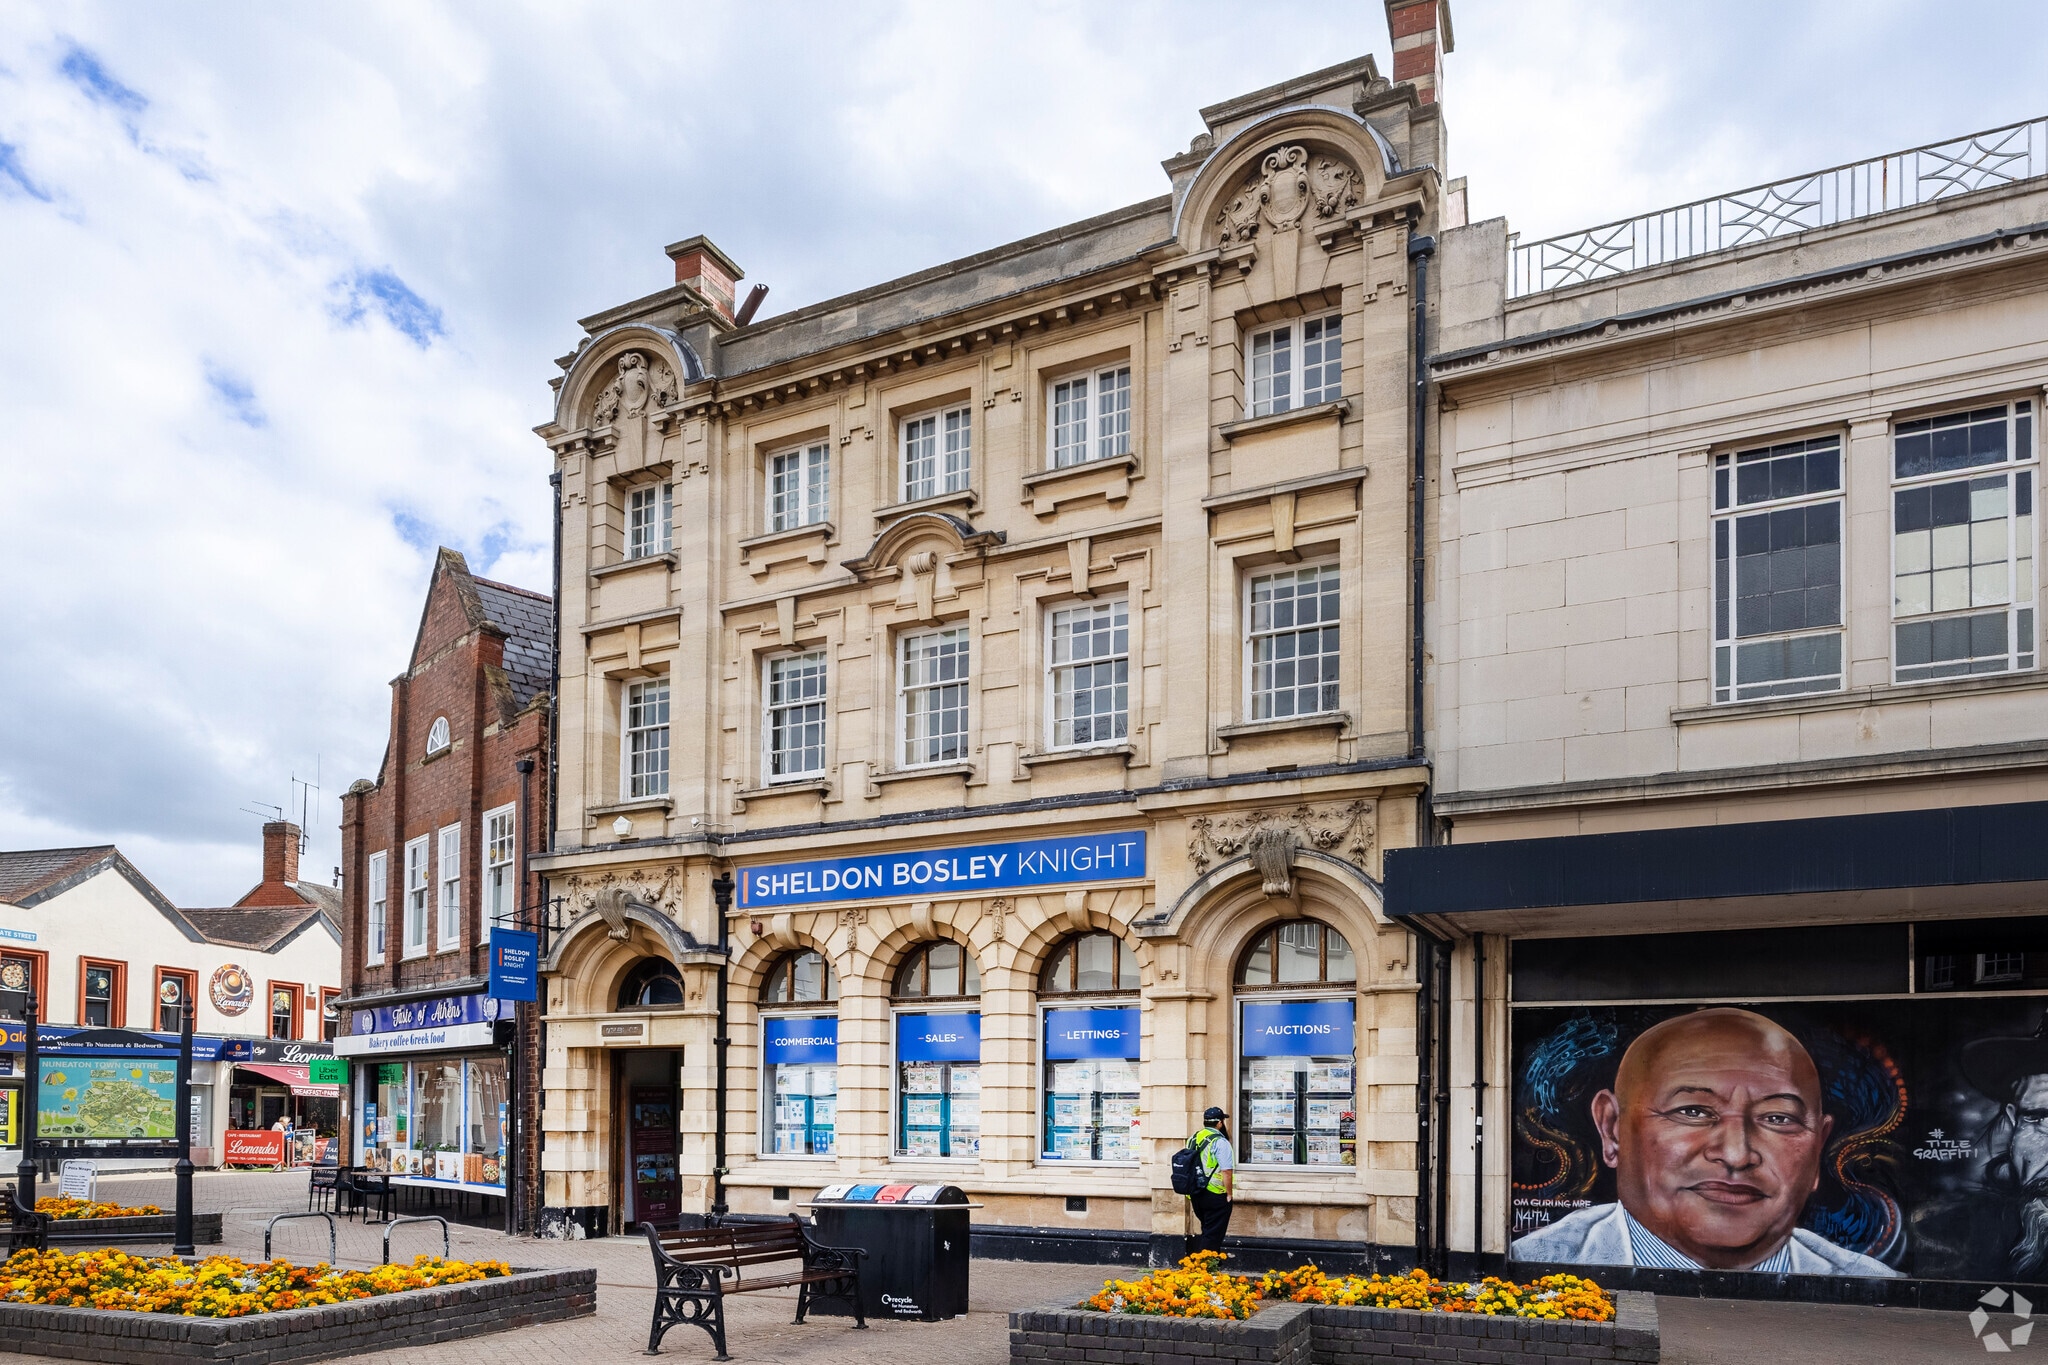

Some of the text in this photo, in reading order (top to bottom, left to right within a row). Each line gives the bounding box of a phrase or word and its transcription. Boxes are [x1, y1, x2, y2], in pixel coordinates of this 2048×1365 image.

[755, 842, 1137, 898] SHELDON BOSLEY KNIGHT
[13, 932, 36, 940] STREET
[504, 948, 530, 956] SHELDON
[504, 955, 525, 963] BOSLEY
[392, 1001, 461, 1027] Taste of Athens
[1265, 1024, 1331, 1035] AUCTIONS
[925, 1034, 957, 1043] SALES
[1066, 1030, 1120, 1040] LETTINGS
[368, 1031, 446, 1050] Bakery coffee Greek food
[775, 1037, 835, 1047] COMMERCIAL
[1925, 1140, 1971, 1148] TITLE
[1913, 1148, 1978, 1160] GRAFFITI
[1513, 1198, 1529, 1206] OM
[1530, 1198, 1572, 1208] GURUNG
[892, 1296, 913, 1305] recycle
